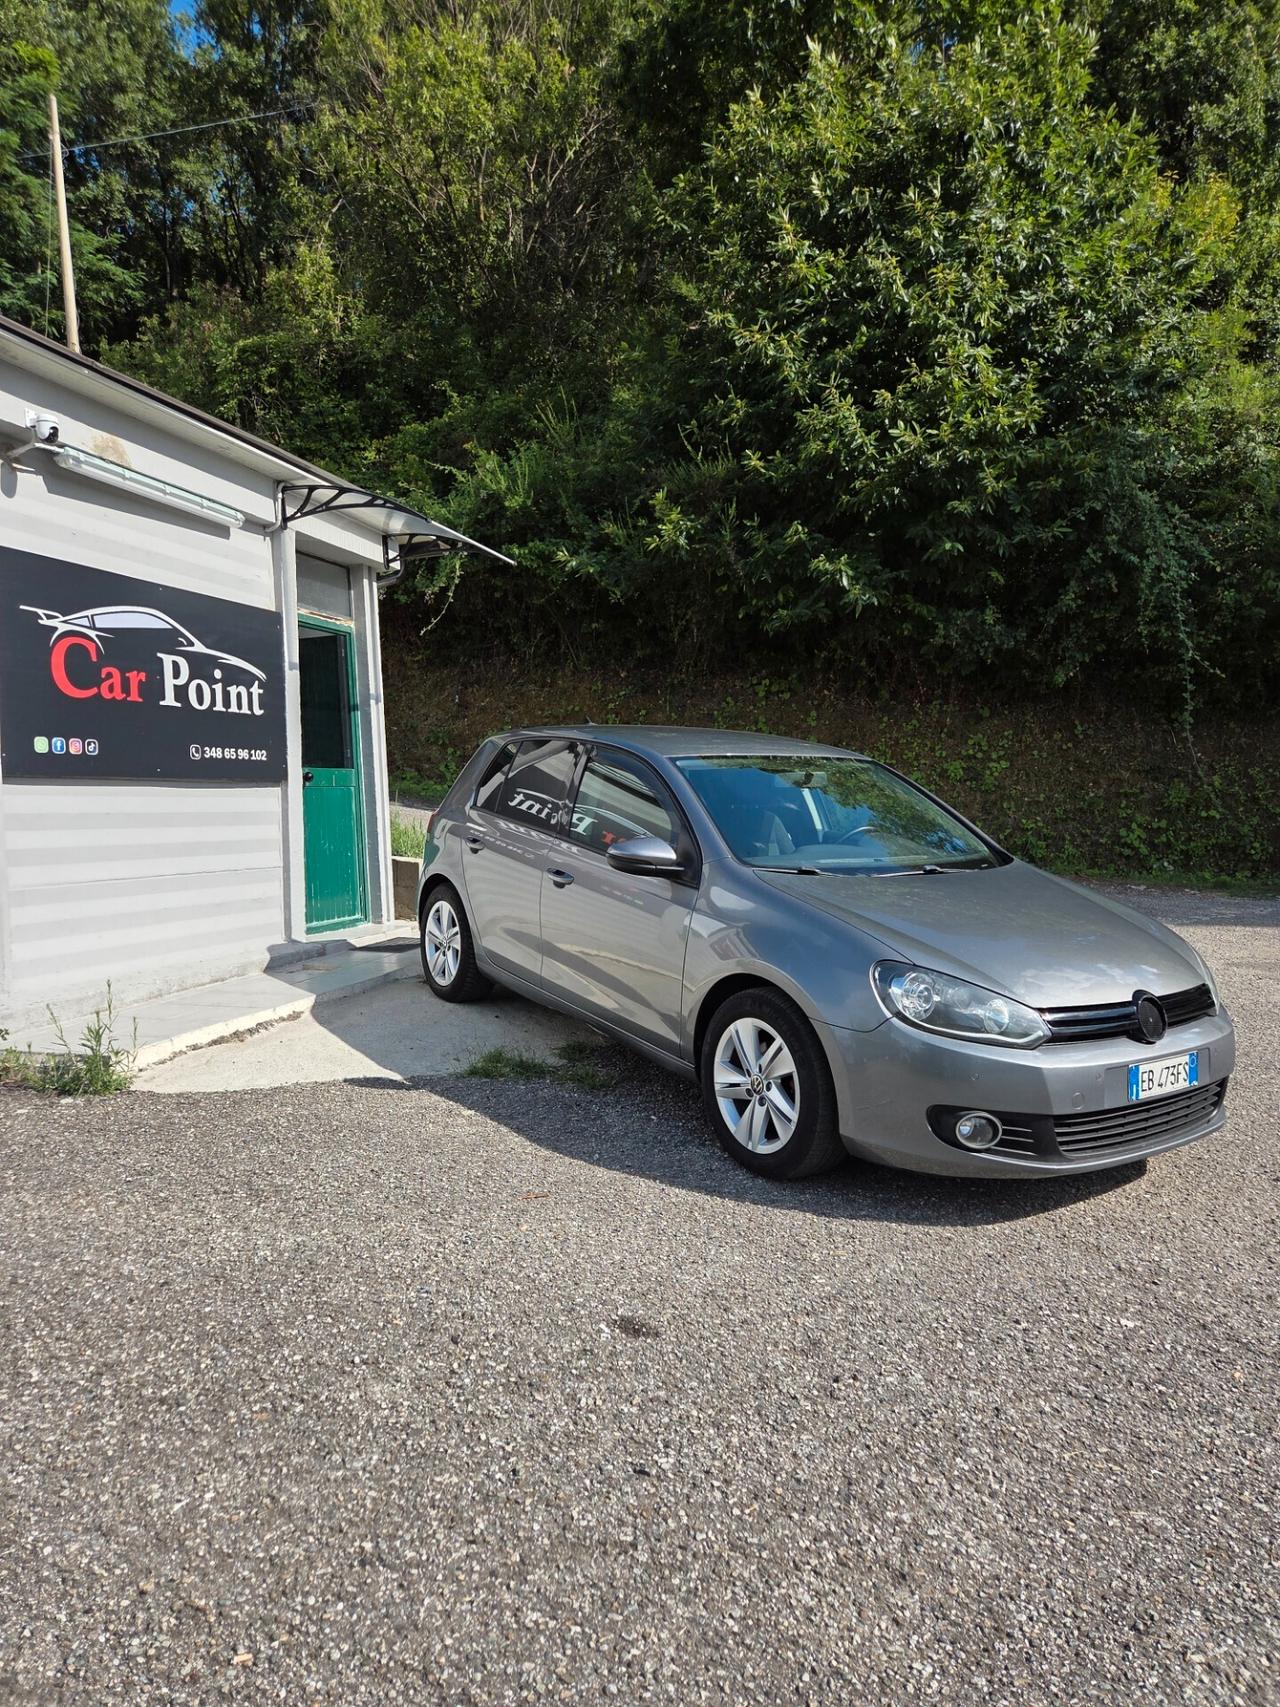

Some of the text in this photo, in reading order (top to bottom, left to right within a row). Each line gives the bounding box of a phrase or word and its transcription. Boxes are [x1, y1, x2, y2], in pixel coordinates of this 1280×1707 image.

[51, 636, 265, 716] Car Point
[203, 746, 267, 761] 348 65 96 102
[1141, 1061, 1189, 1092] EB 473FS
